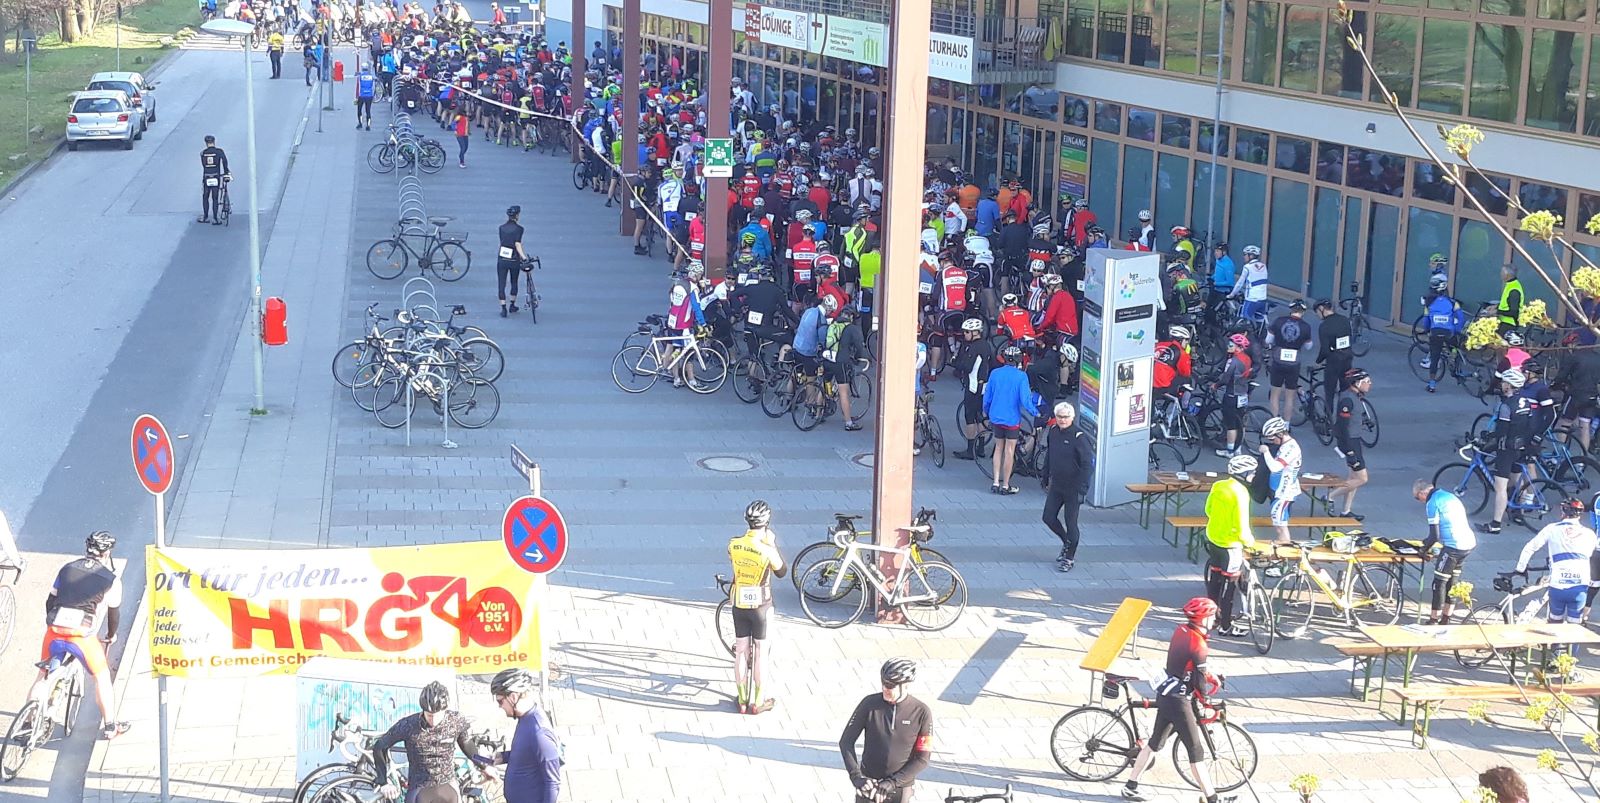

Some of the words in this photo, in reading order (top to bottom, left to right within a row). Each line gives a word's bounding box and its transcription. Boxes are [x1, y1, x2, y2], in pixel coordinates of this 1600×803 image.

[761, 15, 792, 35] LOUNGE
[1063, 134, 1086, 147] EINGANG
[248, 563, 368, 598] jeden...
[480, 601, 505, 611] Von
[227, 594, 425, 653] HRG
[476, 611, 510, 623] 1951
[484, 623, 505, 633] e.V.
[152, 653, 204, 669] dsport
[210, 652, 328, 668] Gemeinsch
